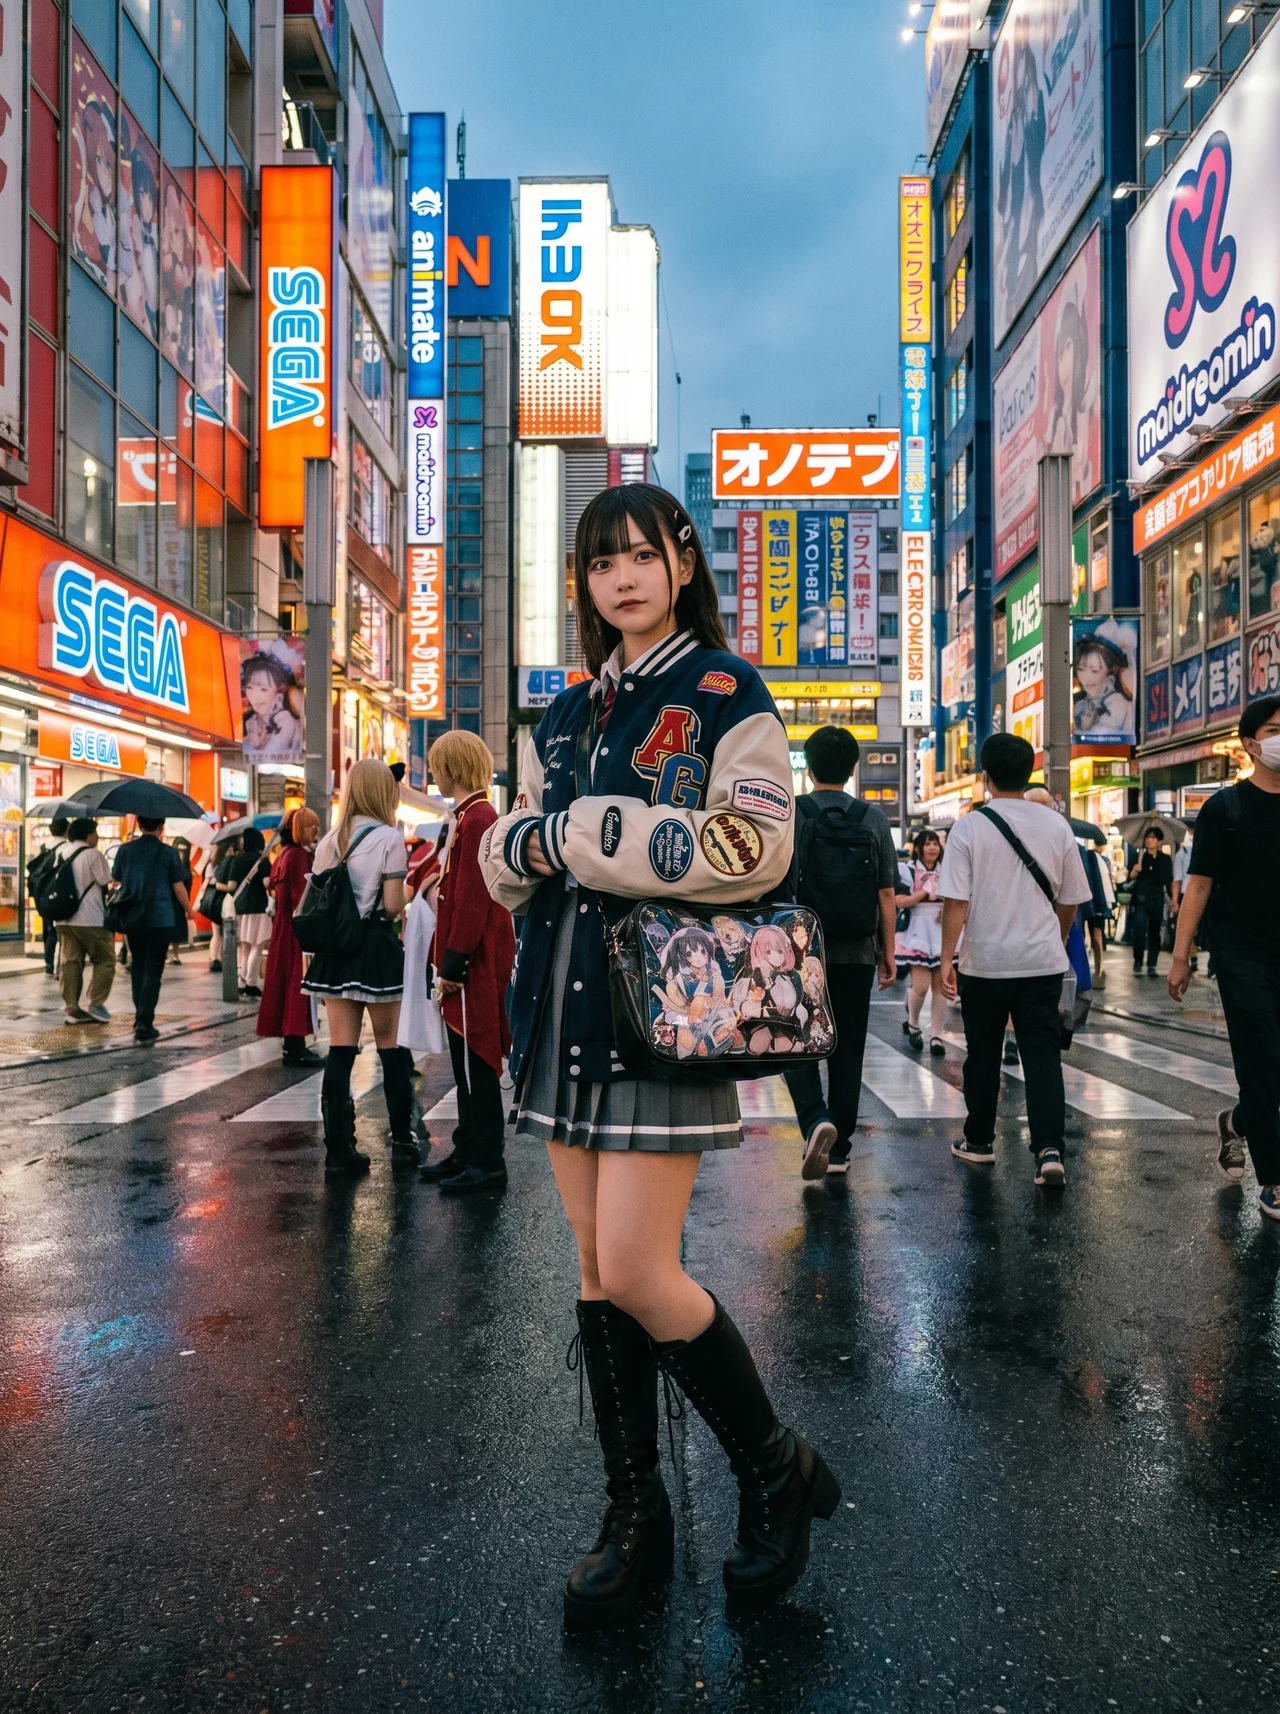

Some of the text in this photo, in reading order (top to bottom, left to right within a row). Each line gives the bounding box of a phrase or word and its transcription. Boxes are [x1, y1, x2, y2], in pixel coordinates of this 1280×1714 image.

[412, 230, 443, 363] animate
[447, 235, 490, 287] N
[267, 266, 325, 430] SEGA
[1139, 304, 1274, 459] maidreamin
[415, 433, 434, 536] maidreamin
[53, 561, 190, 714] SEGA
[70, 724, 121, 769] SEGA
[632, 705, 698, 777] A
[652, 752, 707, 810] G
